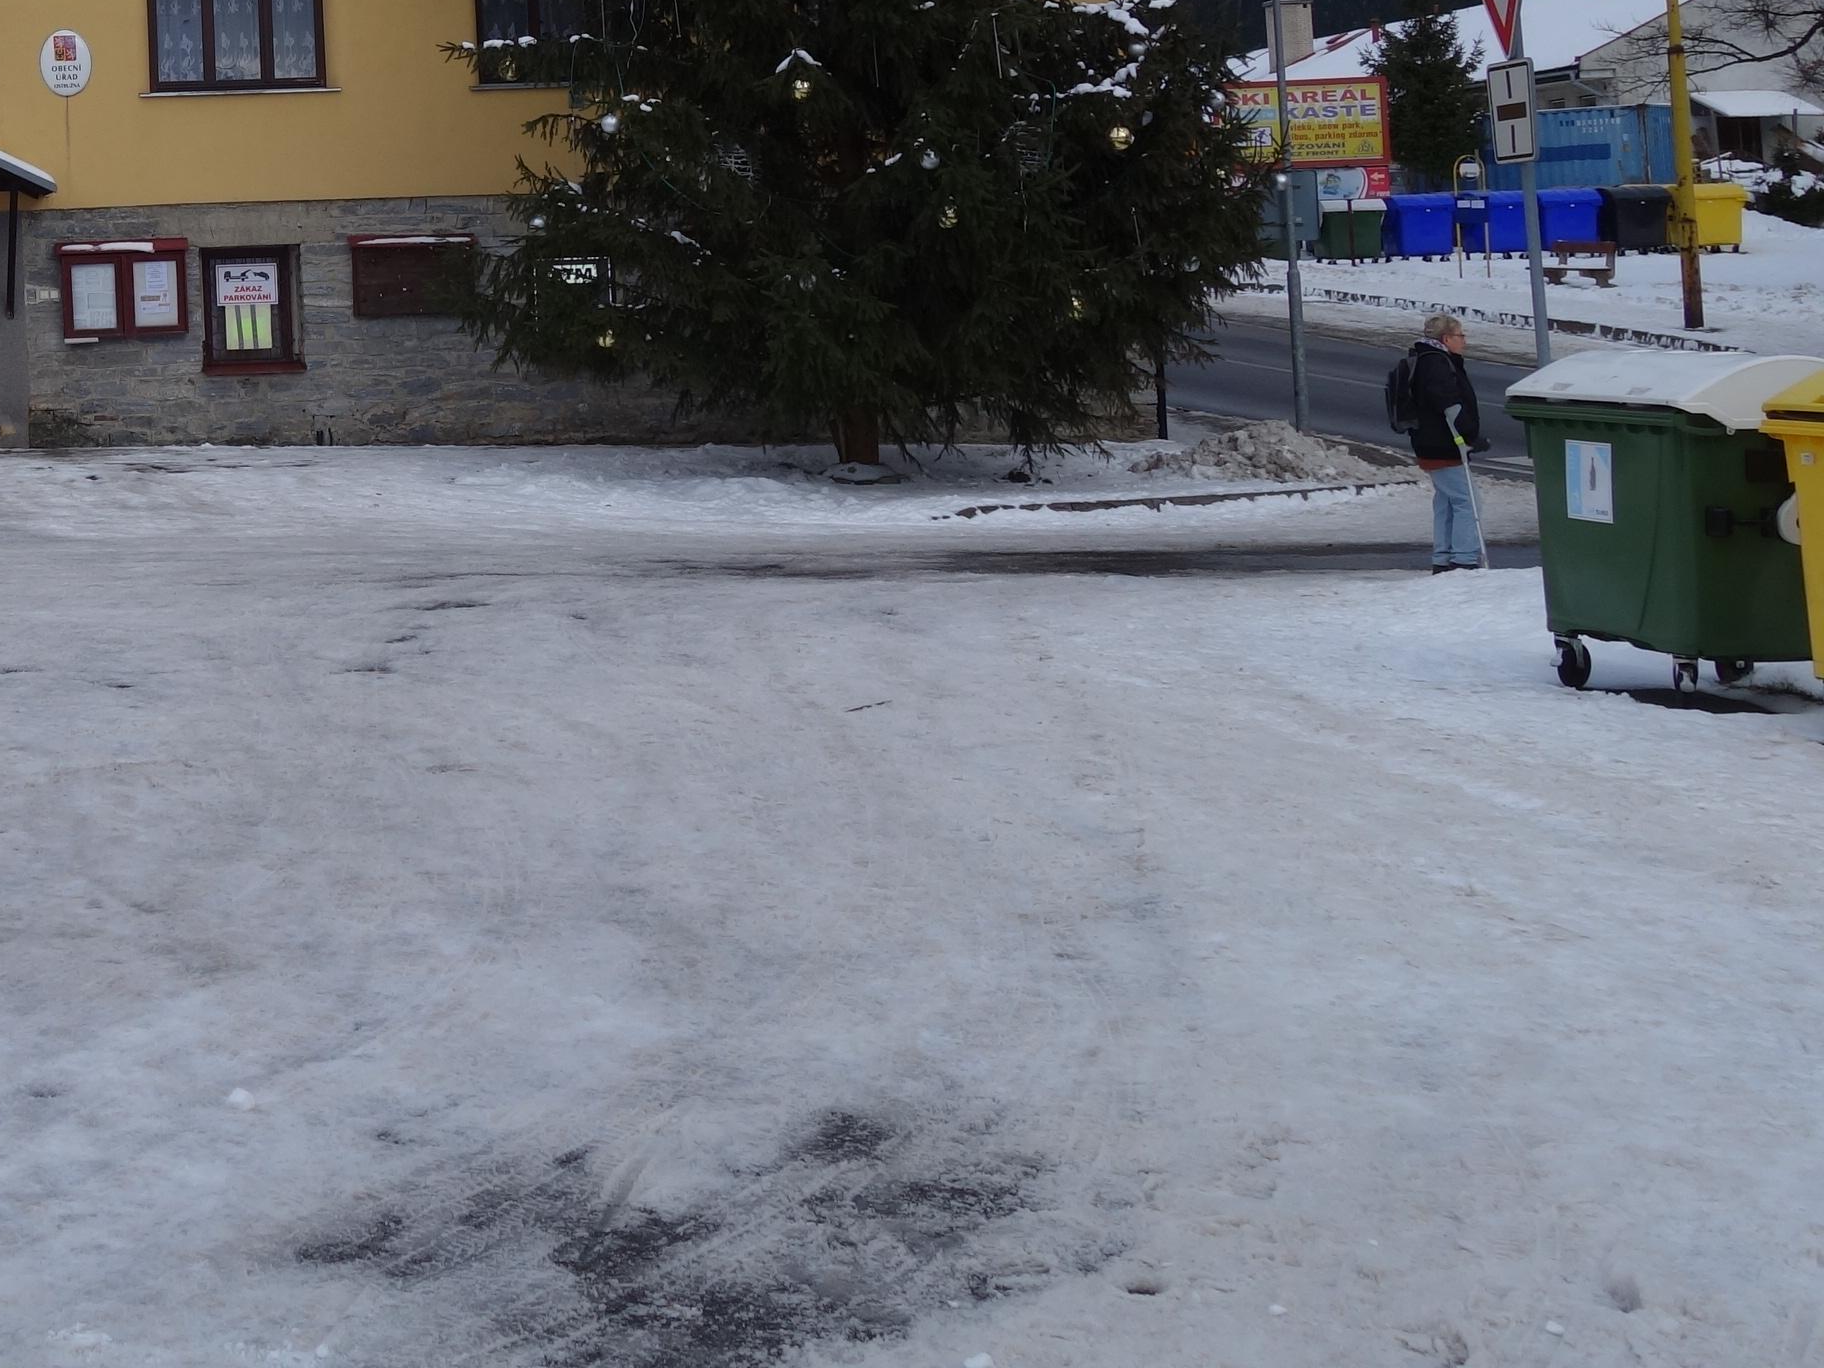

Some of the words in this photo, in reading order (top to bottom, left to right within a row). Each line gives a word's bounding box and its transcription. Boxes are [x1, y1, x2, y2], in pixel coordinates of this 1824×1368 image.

[51, 64, 82, 72] OBECNÍ
[55, 72, 78, 81] ÚŘAD
[1286, 86, 1376, 104] AREÁL
[223, 292, 272, 302] PARKOVÁNÍ
